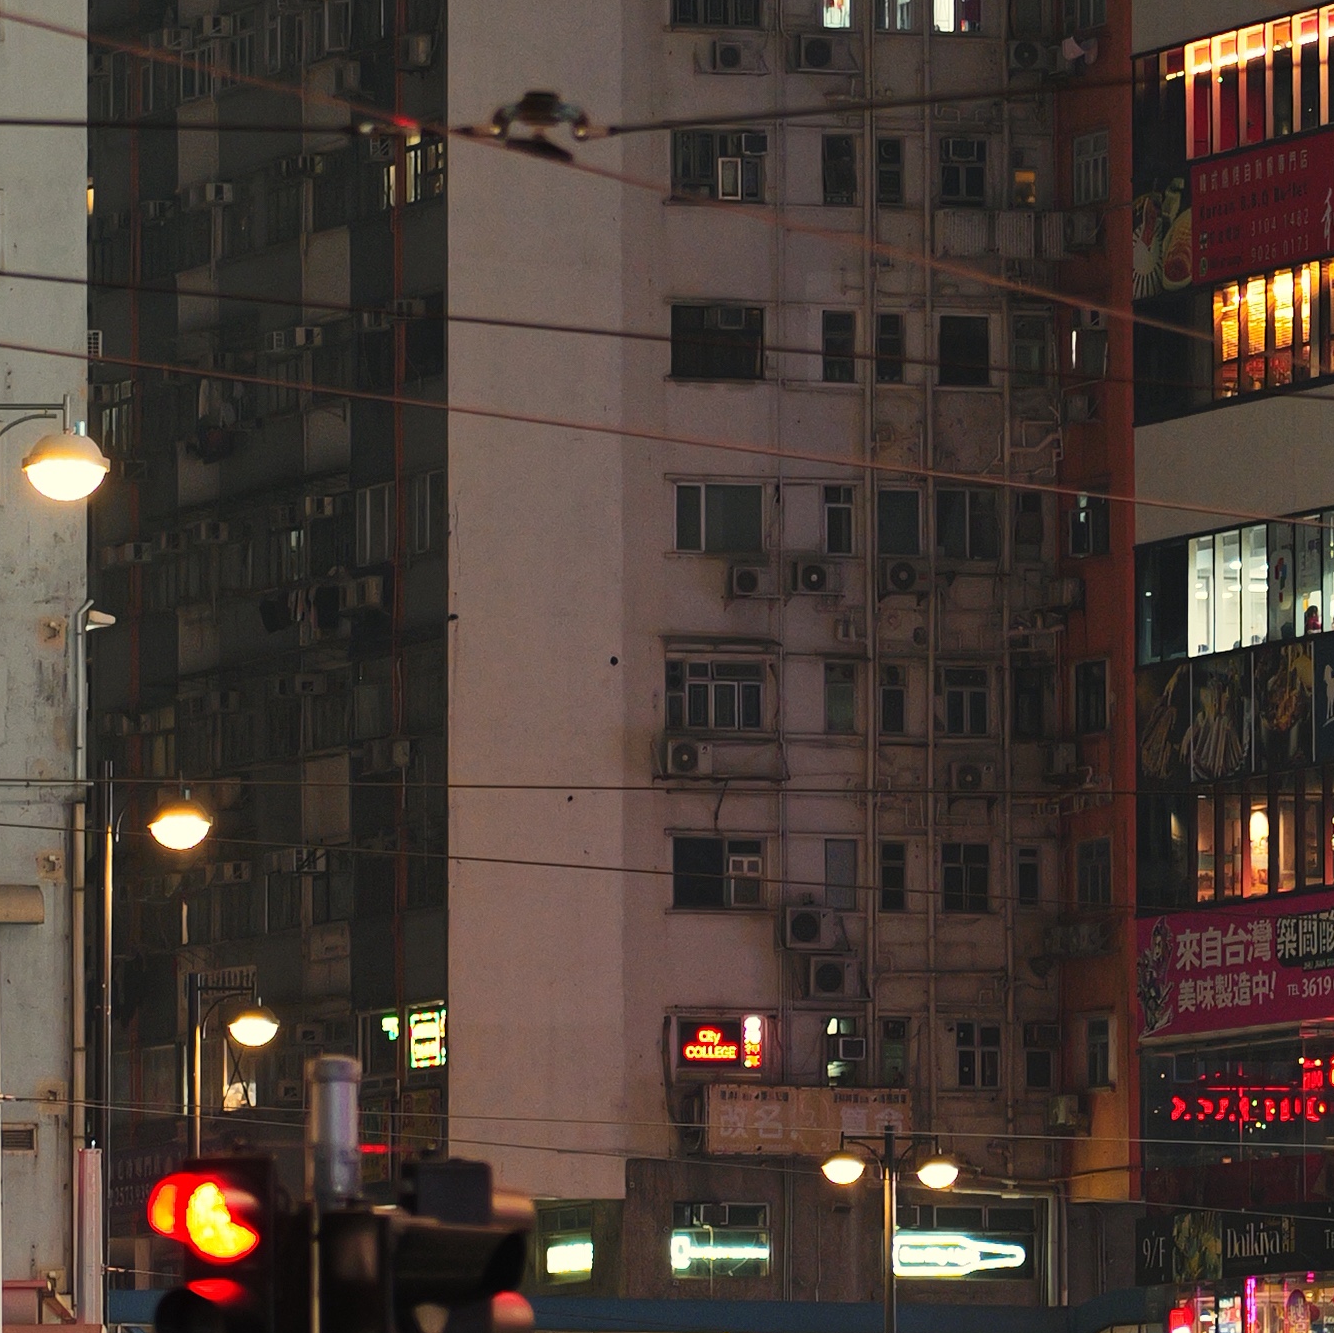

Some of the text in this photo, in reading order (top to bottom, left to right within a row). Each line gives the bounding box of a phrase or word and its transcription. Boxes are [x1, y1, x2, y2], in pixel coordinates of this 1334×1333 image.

[1175, 916, 1273, 972] 來自台灣
[1287, 984, 1299, 996] TEL
[698, 1029, 721, 1045] City
[685, 1045, 738, 1060] COLLEGE
[1226, 1222, 1281, 1264] Daikiya
